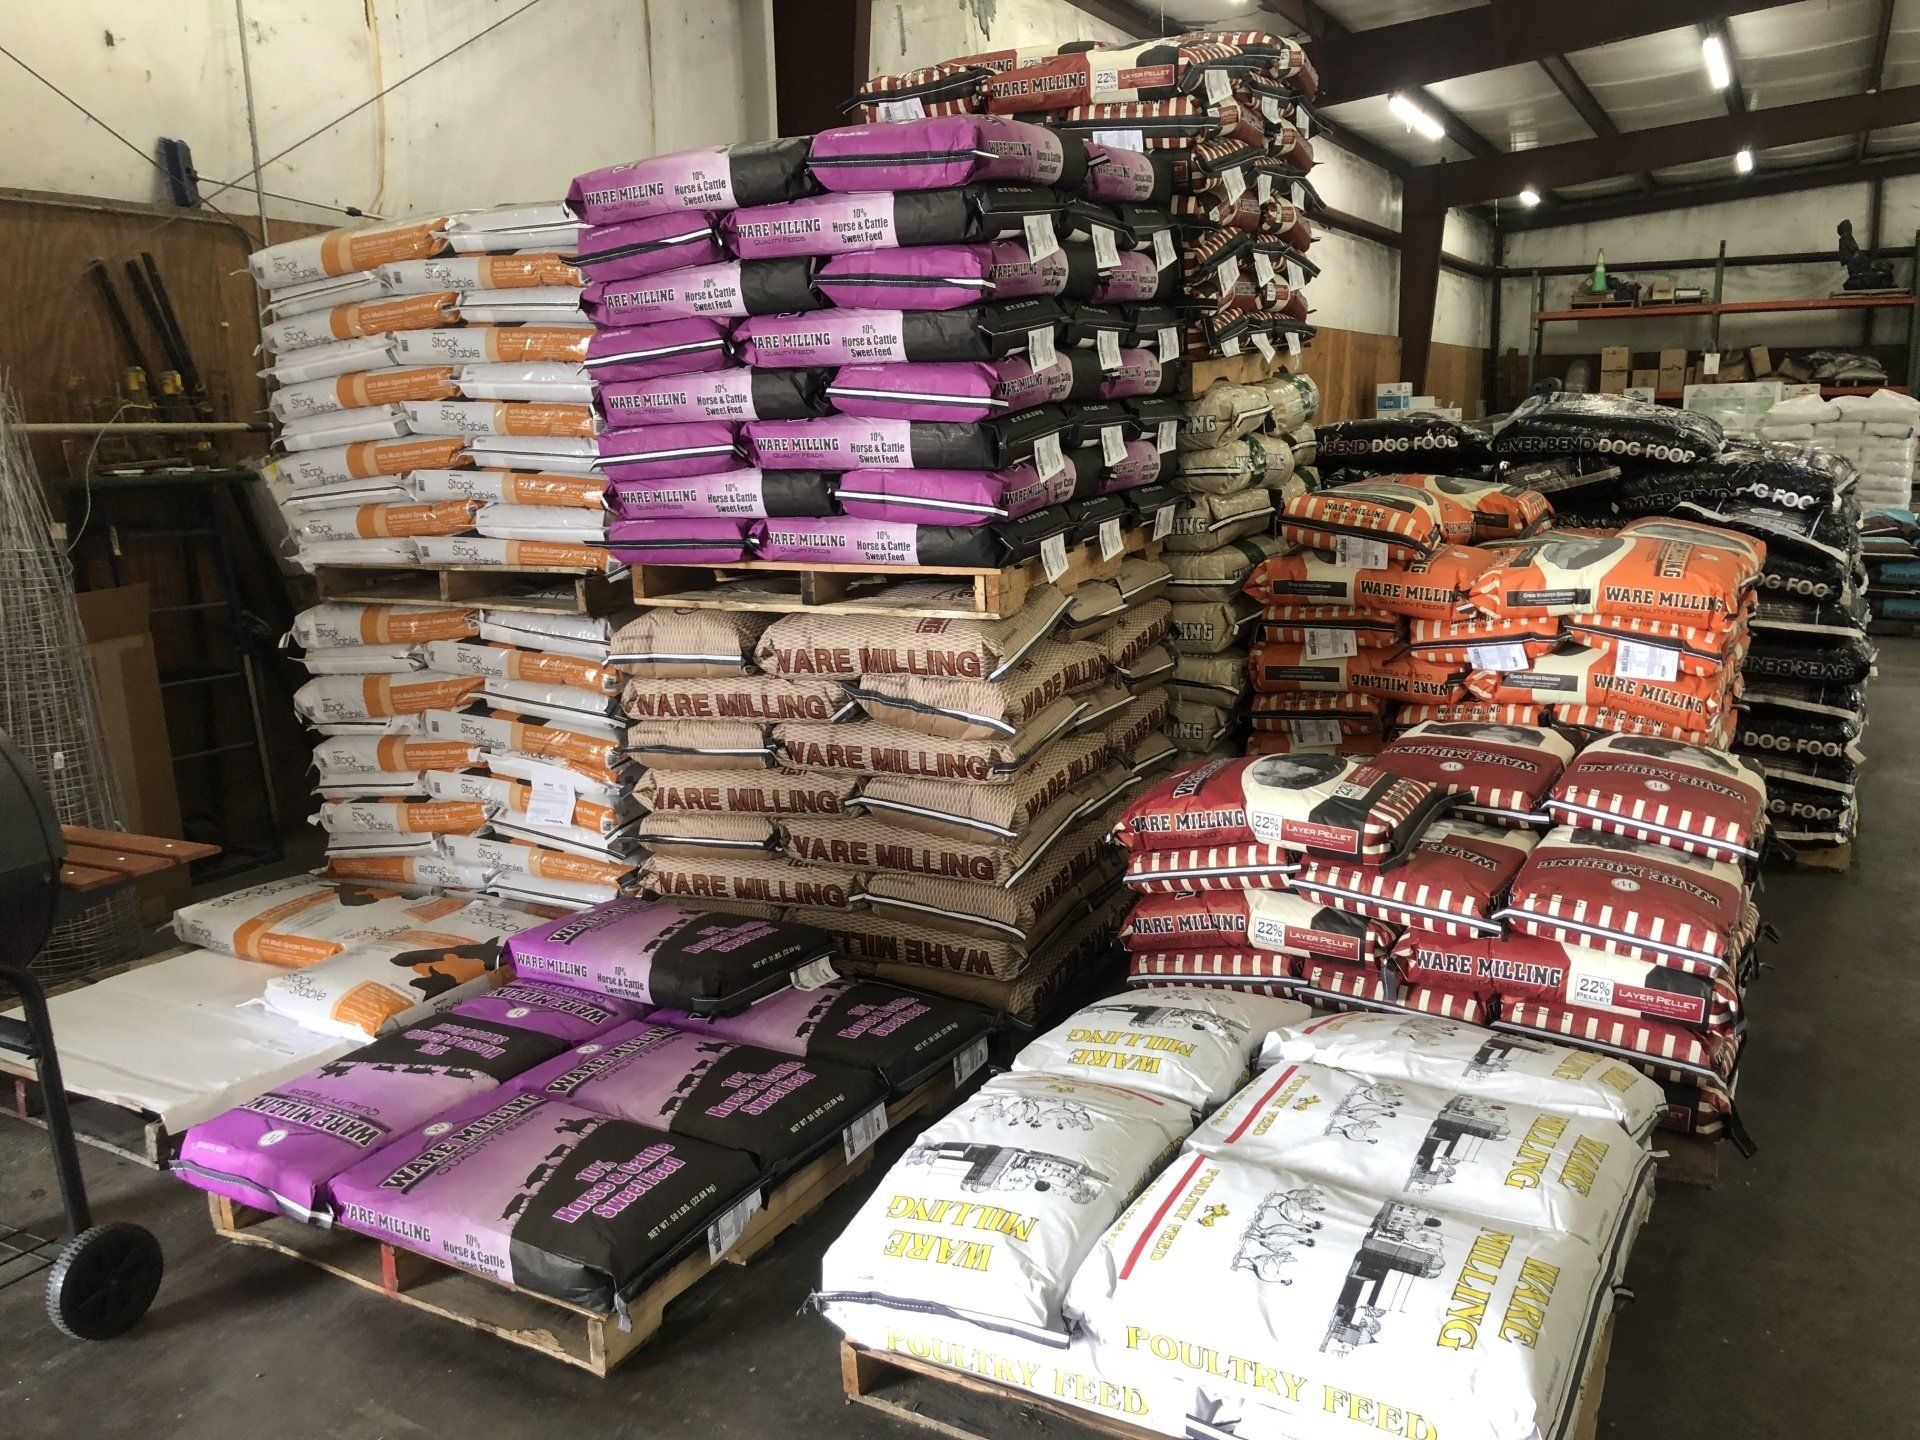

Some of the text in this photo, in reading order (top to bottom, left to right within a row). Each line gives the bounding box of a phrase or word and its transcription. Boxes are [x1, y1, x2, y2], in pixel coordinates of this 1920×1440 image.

[1097, 73, 1116, 83] 22%
[1121, 69, 1170, 79] LAYER PELLET
[992, 79, 1028, 98] WARE
[1031, 72, 1086, 92] MILLING
[691, 171, 705, 180] 10%
[586, 183, 664, 206] WARE MILLING
[674, 179, 726, 196] Horse & Cattle
[683, 192, 722, 206] Sweet Feed
[852, 208, 867, 218] 10%
[737, 216, 888, 238] WARE MILLING Horse & Cattle
[841, 231, 883, 244] Sweet Feed
[424, 267, 452, 280] Stock
[442, 278, 474, 289] Stable
[630, 289, 674, 307] MILLING
[432, 337, 458, 350] Stock
[782, 332, 830, 348] MILLING
[448, 347, 480, 360] Stable
[608, 391, 687, 409] WARE MILLING
[440, 409, 468, 422] Stock
[456, 419, 489, 432] Stable
[756, 438, 905, 454] WARE MILLING Horse & Cattle
[870, 432, 884, 441] 10%
[1325, 435, 1458, 456] BEND DOG FOOD
[858, 454, 900, 464] Sweet Feed
[1547, 436, 1595, 450] BEND
[1600, 438, 1641, 456] DOG
[1646, 444, 1696, 464] FOOD
[620, 490, 758, 504] WARE MILLING Horse & Cattle
[724, 483, 738, 492] 10%
[716, 502, 754, 513] Sweet Feed
[1324, 502, 1386, 520] WARE MILLING
[800, 534, 846, 547] MILLING
[1361, 580, 1401, 598] WARE
[1606, 586, 1724, 613] WARE MILLING
[1626, 605, 1704, 620] QUALITY FEEDS
[859, 647, 982, 679] MILLING
[1022, 652, 1108, 721] WARE MILLING
[716, 693, 828, 720] MILLING
[1640, 684, 1704, 714] MILLING
[1436, 707, 1463, 715] WARE
[1744, 732, 1791, 752] DOG
[871, 747, 989, 781] MILLING
[728, 788, 840, 814] MILLING
[1174, 808, 1246, 832] MILLING
[1255, 815, 1280, 831] 22%
[1286, 824, 1354, 843] LAYER PELLET
[477, 848, 504, 861] Stock
[876, 844, 994, 881] MILLING
[492, 860, 524, 873] Stable
[734, 877, 846, 907] MILLING
[1178, 914, 1246, 932] MILLING
[1257, 922, 1283, 936] 22%
[1289, 930, 1355, 950] LAYER PELLET
[516, 952, 588, 978] WARE MILLING
[904, 939, 995, 976] WARE
[1416, 948, 1562, 988] WARE MILLING
[289, 984, 327, 1001] Stable
[597, 974, 644, 992] Horse Cattle
[1580, 977, 1612, 996] 22%
[1576, 992, 1612, 1004] PELLET
[1618, 988, 1698, 1010] LAYER PELLET
[1066, 1028, 1200, 1058] MILLING
[1068, 1048, 1162, 1074] WARE
[546, 1056, 602, 1096] WARE
[720, 1072, 756, 1088] 10%
[704, 1088, 758, 1118] Horse
[756, 1061, 806, 1082] Cattle
[740, 1070, 817, 1116] Sweet Feed
[1253, 1072, 1310, 1137] POULTRY FEED
[384, 1092, 547, 1191] WARE MILLING
[1504, 1112, 1550, 1194] MILLING
[576, 1160, 618, 1182] 10%
[1558, 1131, 1612, 1198] WARE
[552, 1142, 676, 1224] Horse & Cattle
[592, 1156, 687, 1219] Sweet Feed
[648, 1226, 659, 1240] NET
[658, 1216, 672, 1232] WT.
[670, 1211, 680, 1222] 50
[678, 1202, 692, 1217] LBS.
[706, 1183, 718, 1194] kg)
[886, 1194, 1040, 1244] MILLING
[1150, 1167, 1220, 1262] POULTRY FEED
[378, 1211, 432, 1244] MILLING
[464, 1232, 482, 1250] 10%
[883, 1229, 995, 1272] WARE
[442, 1238, 506, 1269] Horse & Cattle
[1436, 1226, 1516, 1352] MILLING
[1497, 1256, 1562, 1350] WARE
[887, 1326, 1150, 1418] POULTRY FEED
[1124, 1325, 1438, 1440] POULTRY FEED
